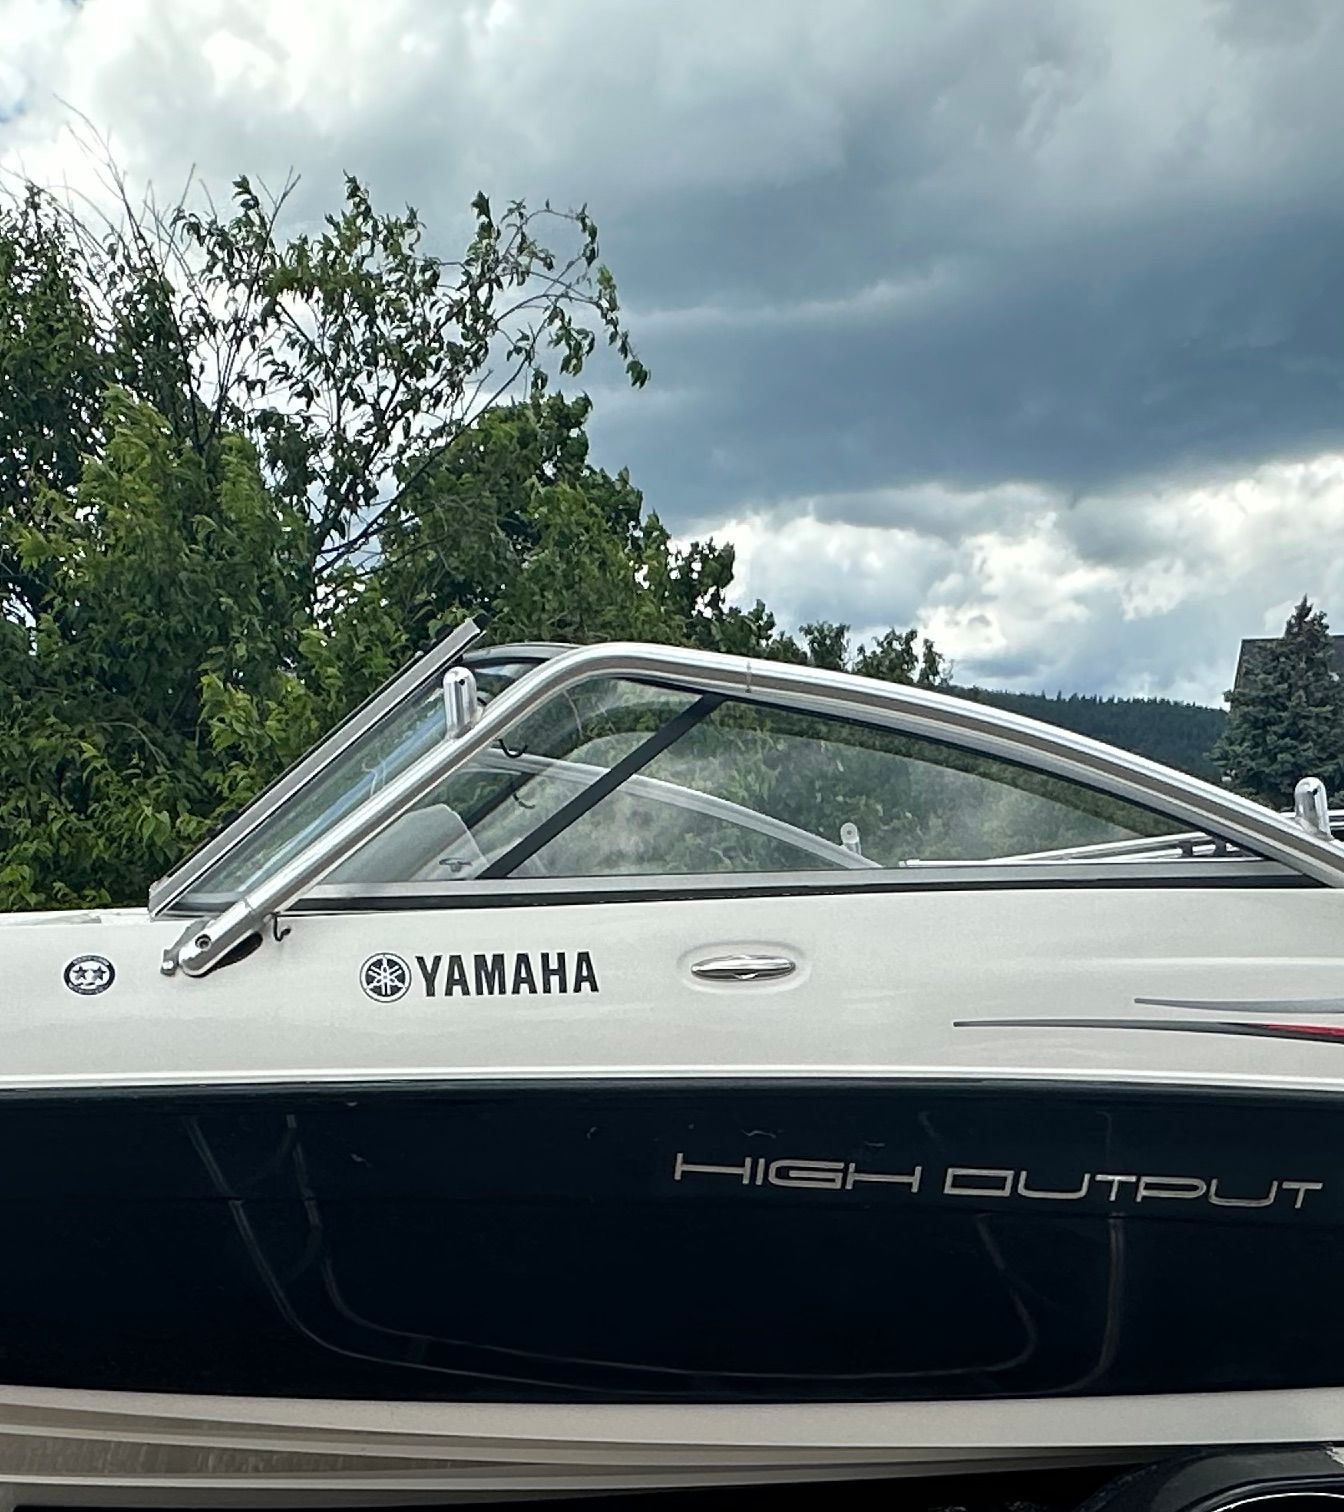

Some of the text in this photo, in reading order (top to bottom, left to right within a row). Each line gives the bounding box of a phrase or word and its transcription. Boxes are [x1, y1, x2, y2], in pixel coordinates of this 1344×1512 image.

[415, 951, 600, 998] YAMAHA
[673, 1152, 1324, 1210] HIGH OUTPUT
